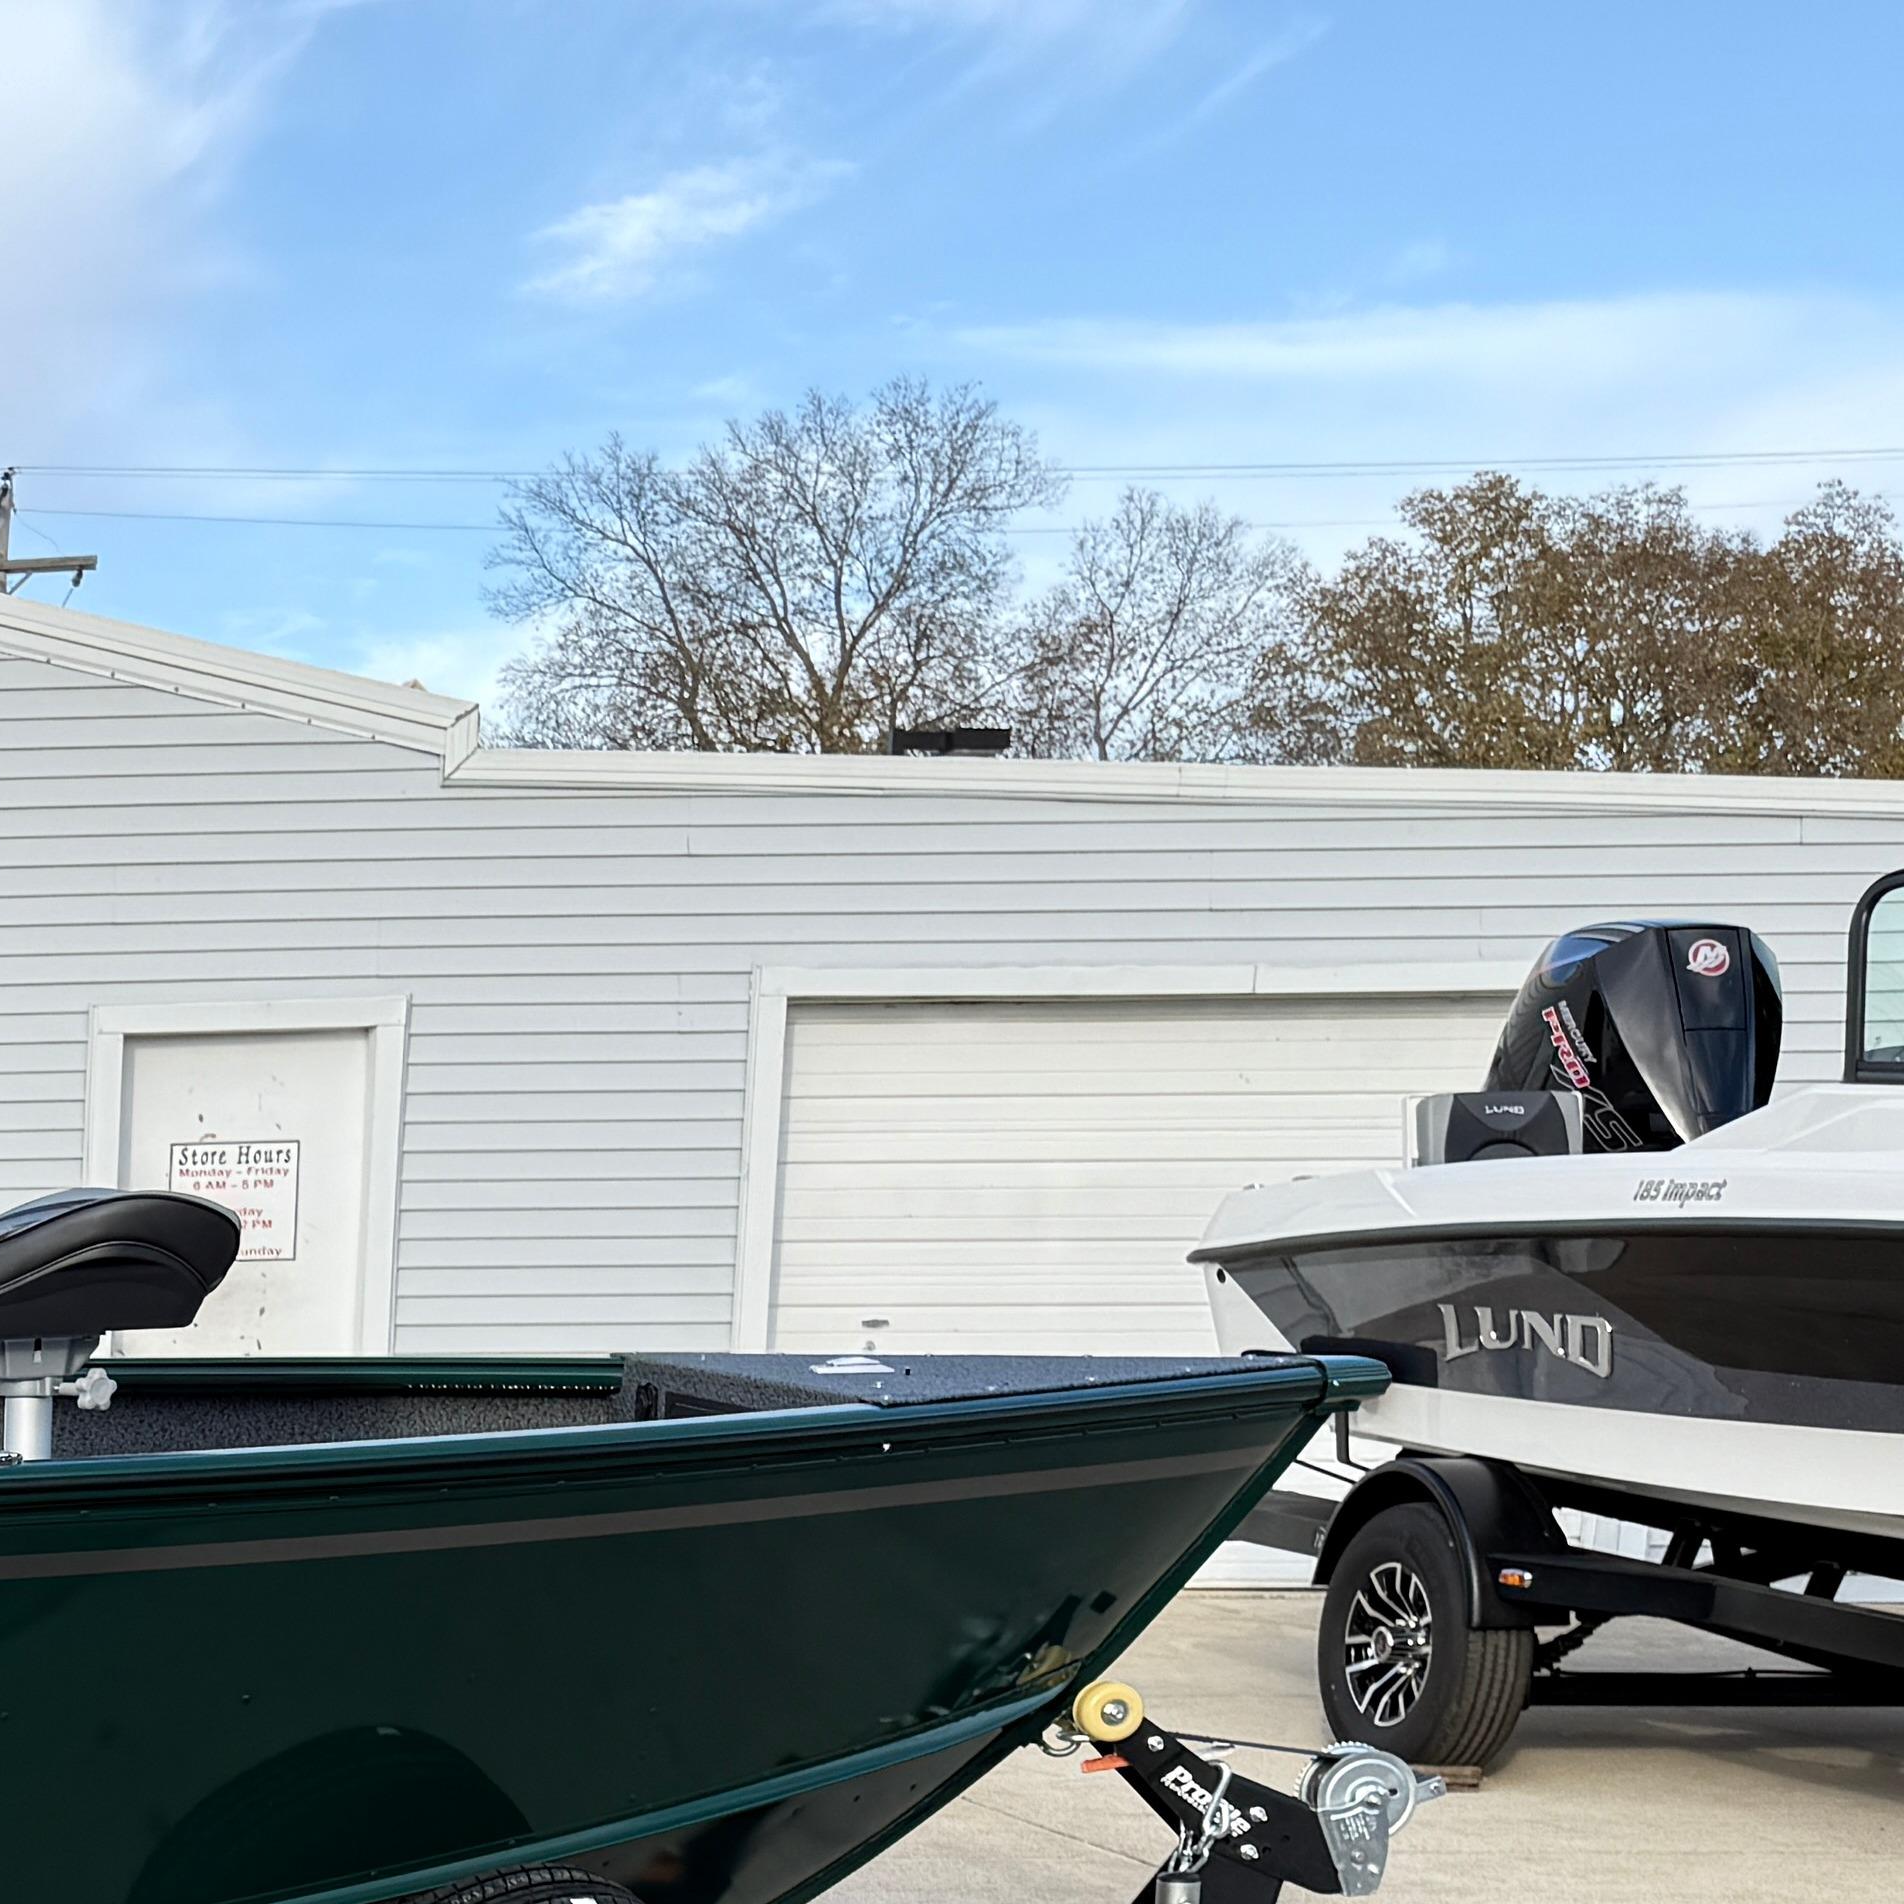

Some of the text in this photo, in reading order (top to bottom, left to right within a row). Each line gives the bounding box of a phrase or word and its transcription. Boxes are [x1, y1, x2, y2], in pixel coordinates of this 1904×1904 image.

[1558, 1000, 1598, 1063] MERCURY
[1485, 1104, 1525, 1115] LUND
[178, 1145, 291, 1166] Store Hours
[178, 1168, 232, 1178] Monday
[246, 1166, 289, 1177] Friday
[205, 1180, 227, 1190] AM
[253, 1179, 274, 1189] PM
[1633, 1180, 1665, 1201] 185
[251, 1219, 273, 1229] PM
[240, 1246, 282, 1257] unday
[1437, 1303, 1613, 1378] LUND
